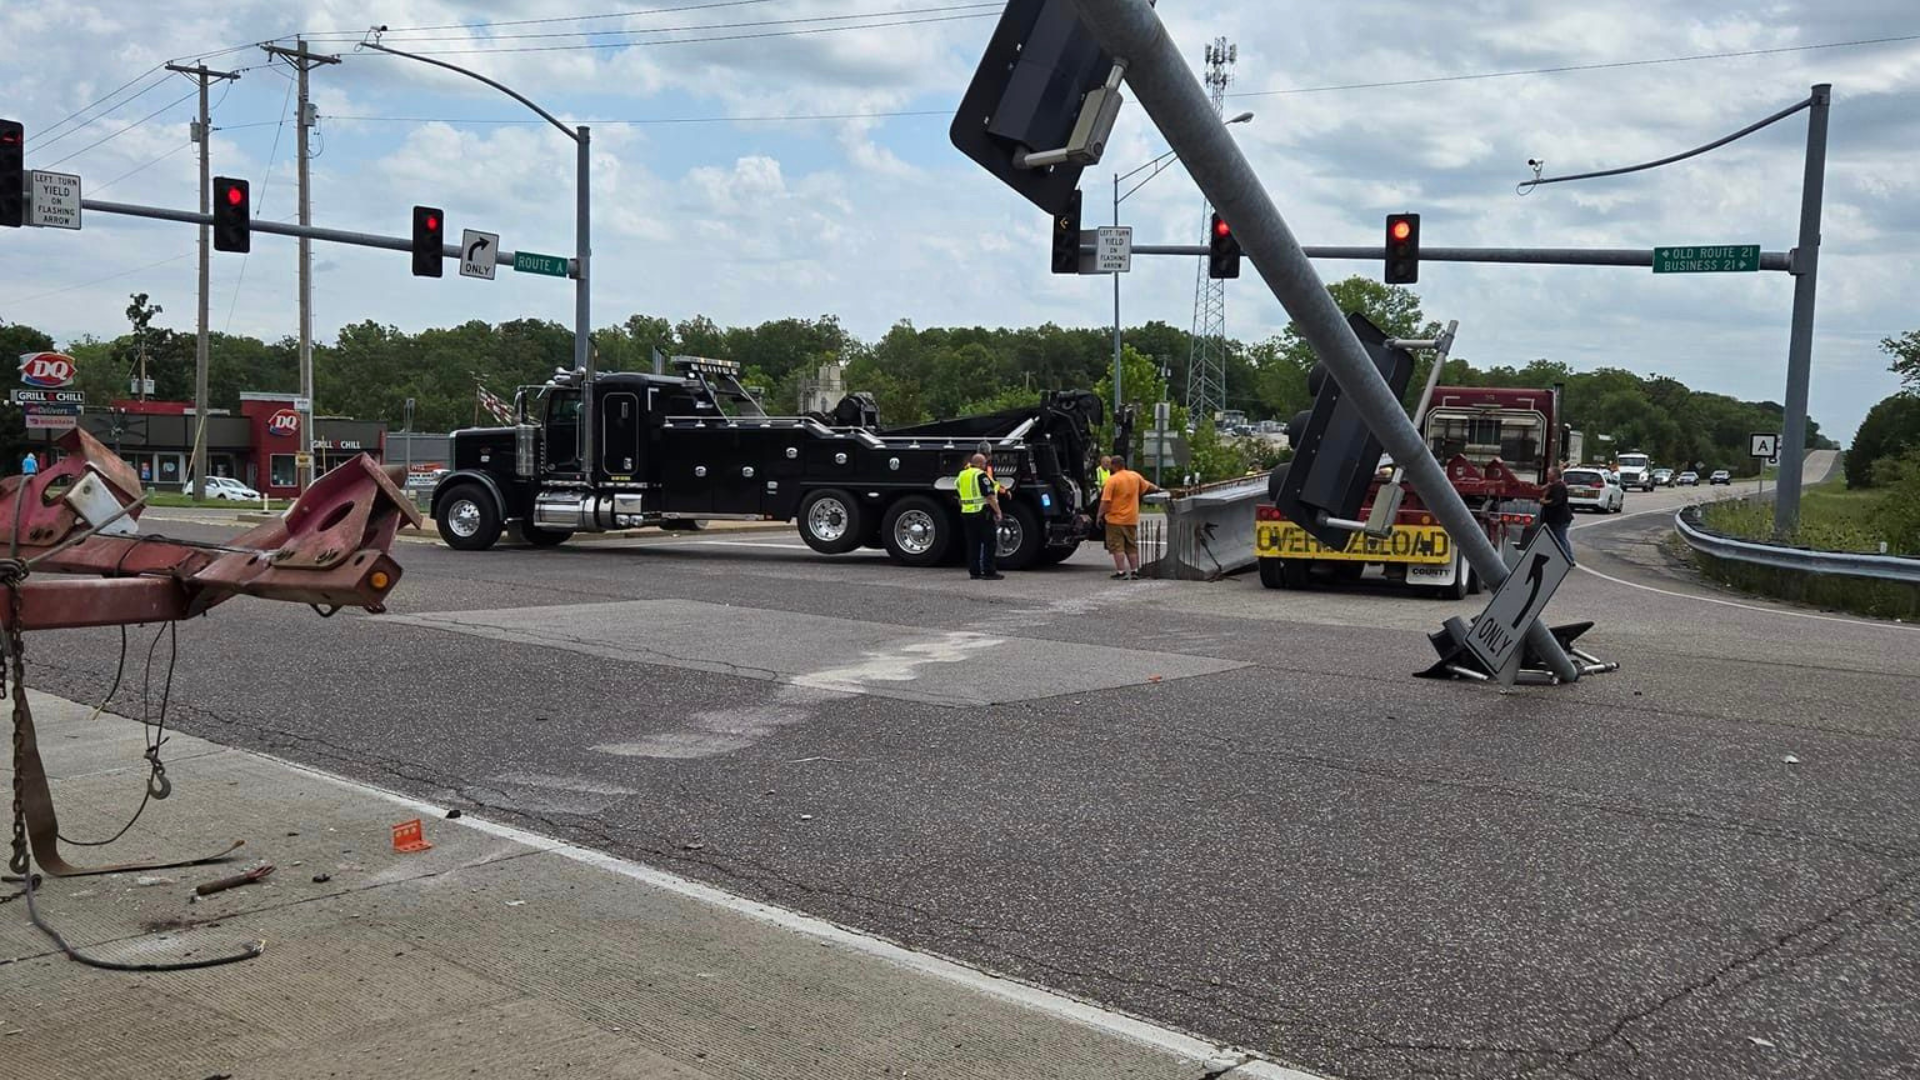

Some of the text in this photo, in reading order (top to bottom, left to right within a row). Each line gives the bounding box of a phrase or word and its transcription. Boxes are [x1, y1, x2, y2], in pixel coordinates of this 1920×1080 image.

[35, 174, 77, 186] LEFT TURN
[43, 184, 70, 197] YIELD
[51, 197, 62, 206] ON
[38, 205, 75, 216] FLASHING
[43, 215, 70, 225] ARROW
[1100, 229, 1112, 237] LEFT
[1105, 238, 1125, 246] YIELD
[1672, 246, 1753, 260] OLD ROUTE 21
[466, 263, 491, 276] ONLY
[518, 256, 564, 274] ROUTE A
[1664, 260, 1735, 272] BUSINESS 21
[32, 360, 69, 380] DQ
[18, 391, 46, 401] GRILL
[56, 393, 82, 402] CHILL
[275, 415, 297, 431] DQ
[340, 440, 361, 450] CHILL
[1758, 440, 1769, 451] A
[1412, 568, 1451, 576] COUNTY
[1478, 617, 1513, 658] ONLY
